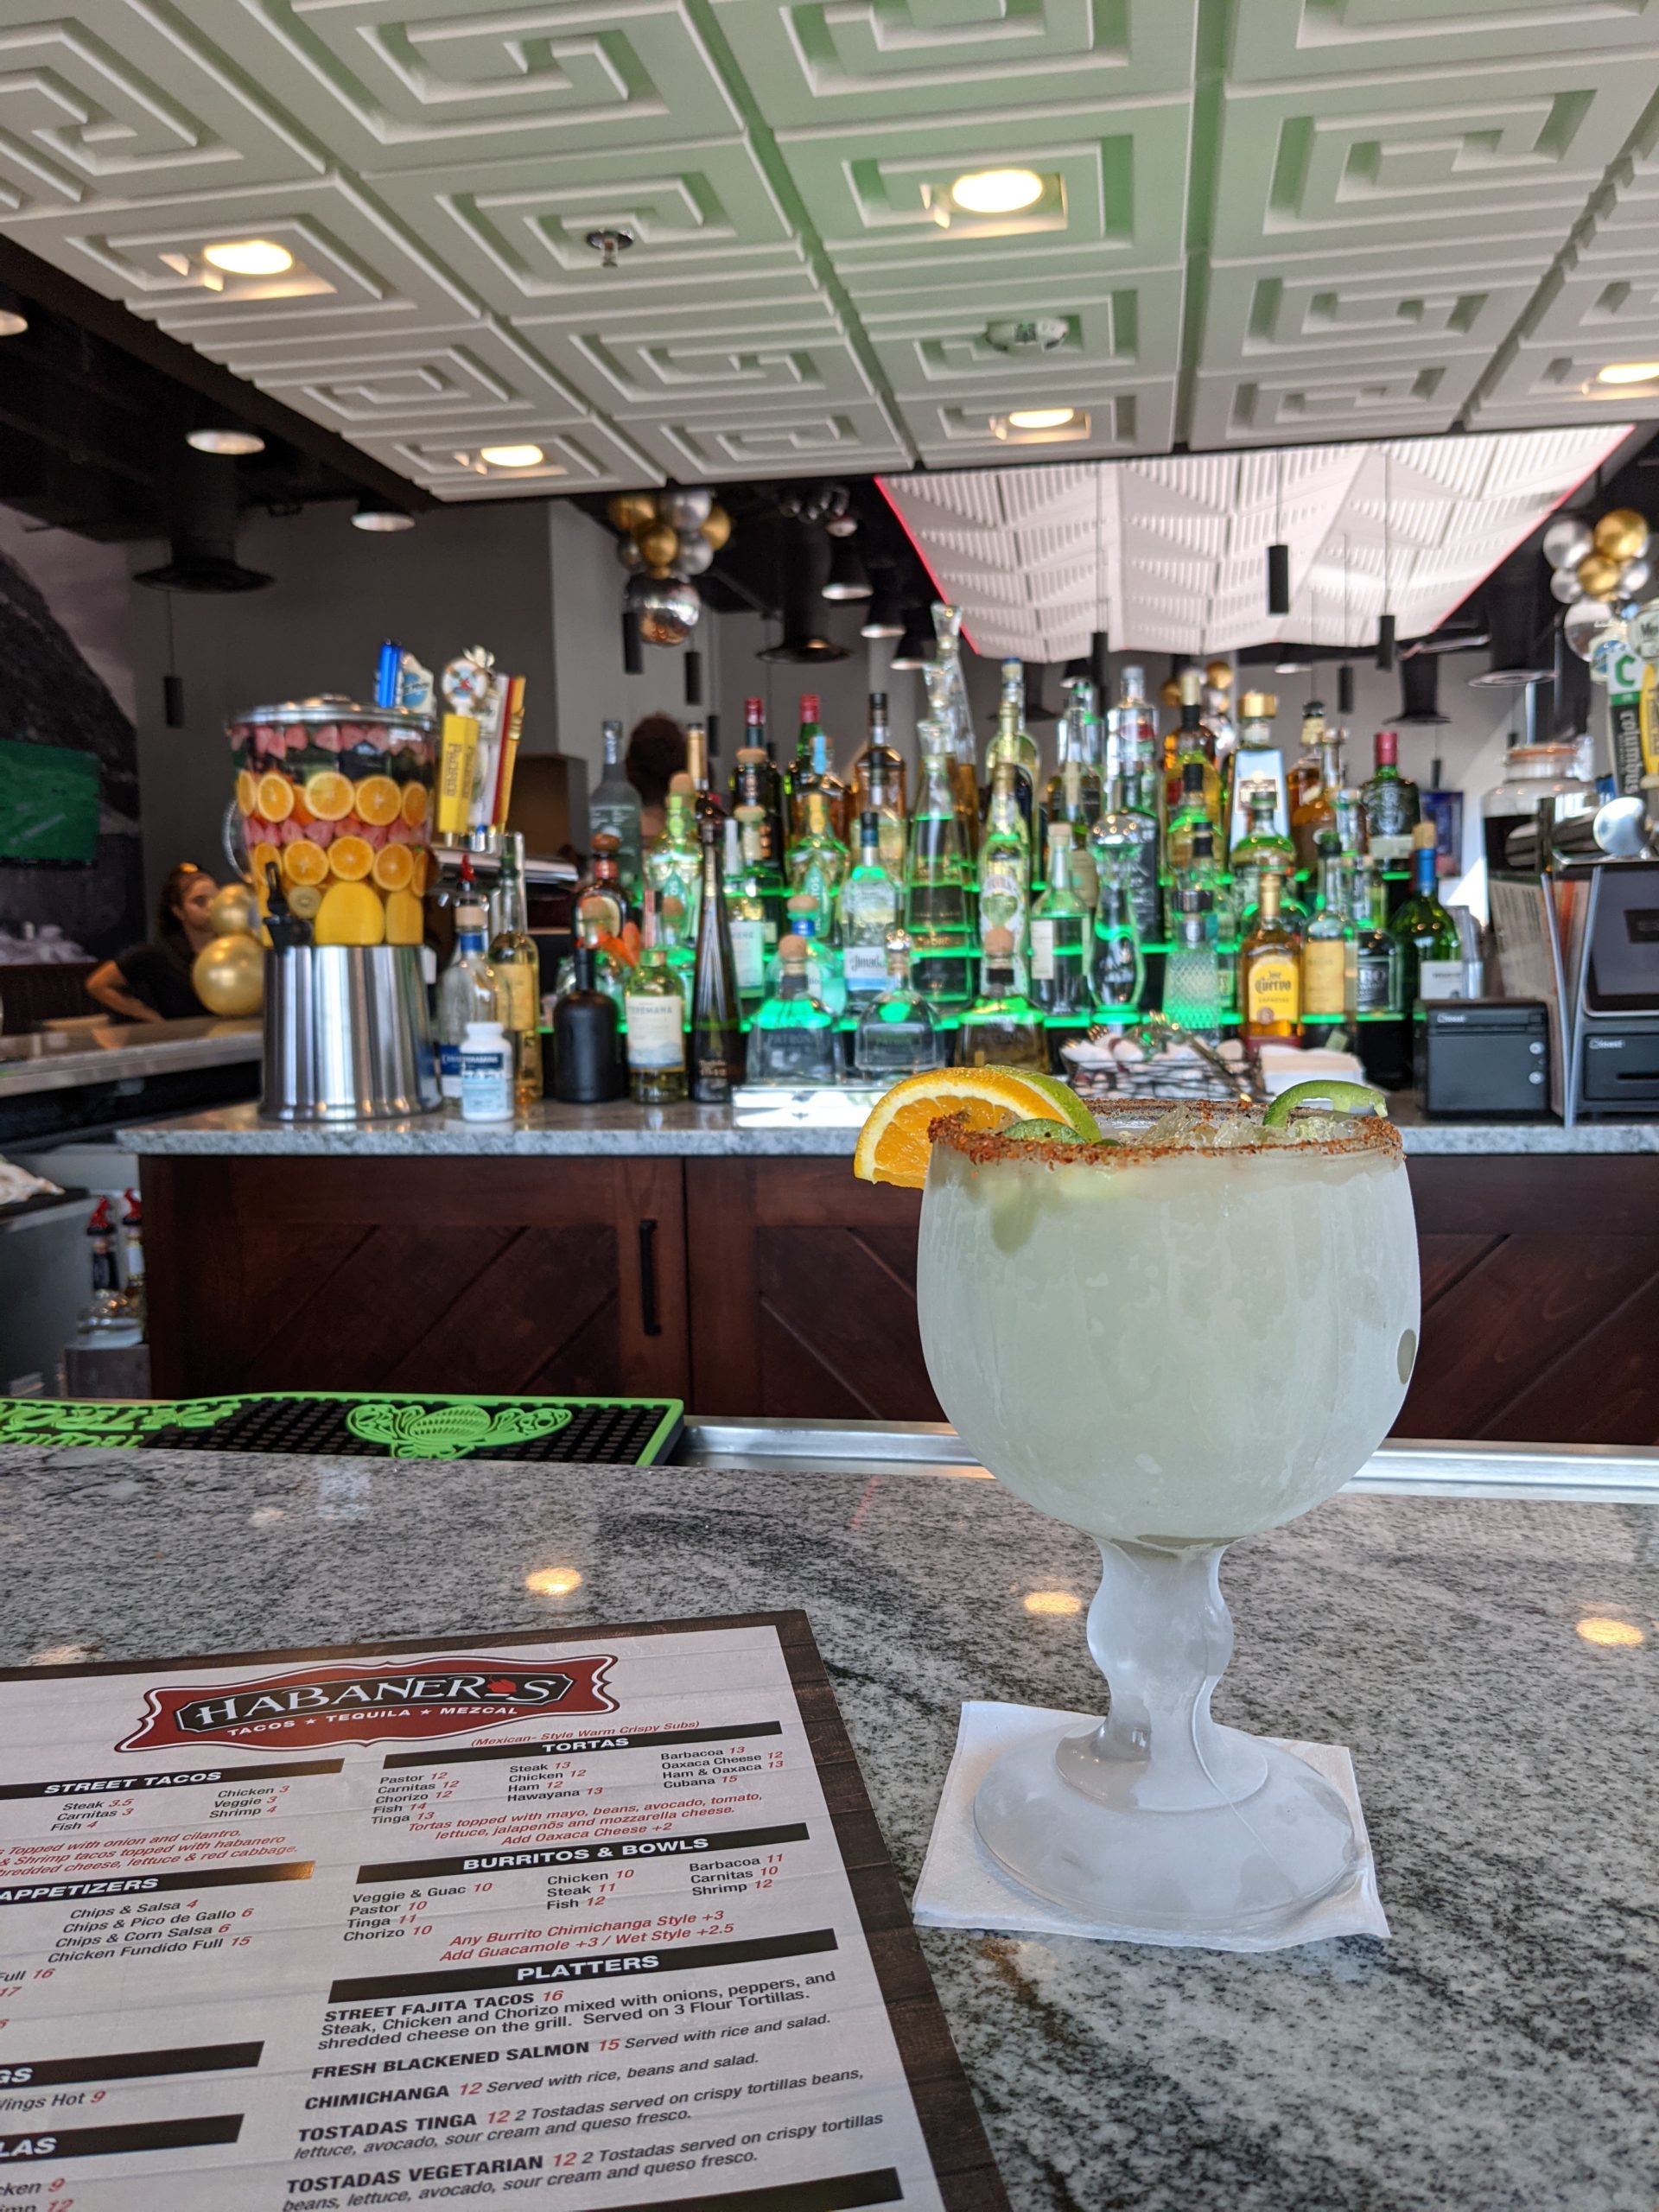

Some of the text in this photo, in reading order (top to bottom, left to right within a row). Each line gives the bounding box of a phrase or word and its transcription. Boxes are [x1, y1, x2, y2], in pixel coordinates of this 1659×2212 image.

[227, 1719, 296, 1737] TACOS
[326, 1709, 410, 1723] TEQUILA
[541, 1731, 574, 1741] Style
[578, 1727, 615, 1738] Warm
[620, 1724, 660, 1736] Crispy
[664, 1720, 700, 1732] Subs)
[542, 1738, 630, 1752] TORTAS
[661, 1749, 723, 1760] Barbacoa
[662, 1759, 710, 1770] Oaxaca
[714, 1754, 762, 1765] Cheese
[510, 1761, 571, 1773] Steak 13
[45, 1771, 222, 1794] STREET TACOS
[380, 1771, 448, 1784] Pastor 12
[509, 1771, 563, 1783] Chicken
[664, 1775, 738, 1789] Cubana 15
[218, 1787, 274, 1798] Chicken
[378, 1780, 460, 1794] Carnitas 12
[508, 1783, 539, 1792] Ham
[214, 1796, 277, 1808] Veggie 3
[375, 1790, 453, 1804] Chorizo 12
[507, 1789, 580, 1802] Hawayana
[62, 1801, 104, 1811] Steak
[373, 1802, 427, 1814] Fish 14
[57, 1809, 118, 1821] Carnitas
[372, 1814, 410, 1824] Tinga
[501, 1822, 673, 1846] Add Oaxaca Cheese +2
[9, 1842, 66, 1856] Topped
[67, 1840, 100, 1851] with
[104, 1838, 145, 1848] onion
[149, 1833, 180, 1844] and
[462, 1838, 709, 1871] BURRITOS & BOWLS
[690, 1853, 784, 1872] Barbacoa 11
[548, 1870, 634, 1885] Chicken 10
[690, 1866, 778, 1884] Carnitas 10
[0, 1878, 159, 1901] APPETIZERS
[353, 1891, 405, 1904] Veggie
[428, 1885, 467, 1897] Guac
[474, 1882, 493, 1892] 10
[547, 1884, 615, 1897] Steak 11
[692, 1879, 772, 1896] Shrimp 12
[71, 1899, 199, 1920] Chips & Salsa 4
[349, 1901, 427, 1916] Pastor 10
[546, 1897, 605, 1910] Fish 12
[62, 1908, 254, 1934] Chips & Pico de Gallo 6
[347, 1915, 416, 1929] Tinga 11
[449, 1910, 724, 1947] Any Burrito Chimichanga Style +3
[343, 1925, 432, 1942] Chorizo 10
[48, 1936, 252, 1963] Chicken Fundido Full 15
[517, 1955, 659, 1980] PLATTERS
[321, 1970, 836, 2036] Steak, Chicken and Chorizo mixed with onions, peppers, and
[324, 1990, 563, 2023] STREET FAJITA TACOS 16
[311, 2013, 830, 2079] FRESH BLACKENED SALMON 15 Served with rice and salad.
[305, 2053, 760, 2110] CHIMICHANGA 12 Served with rice, beans and salad.
[299, 2069, 863, 2142] TOSTADAS TINGA 12 2 Tostadas served on crispy tortillas beans,
